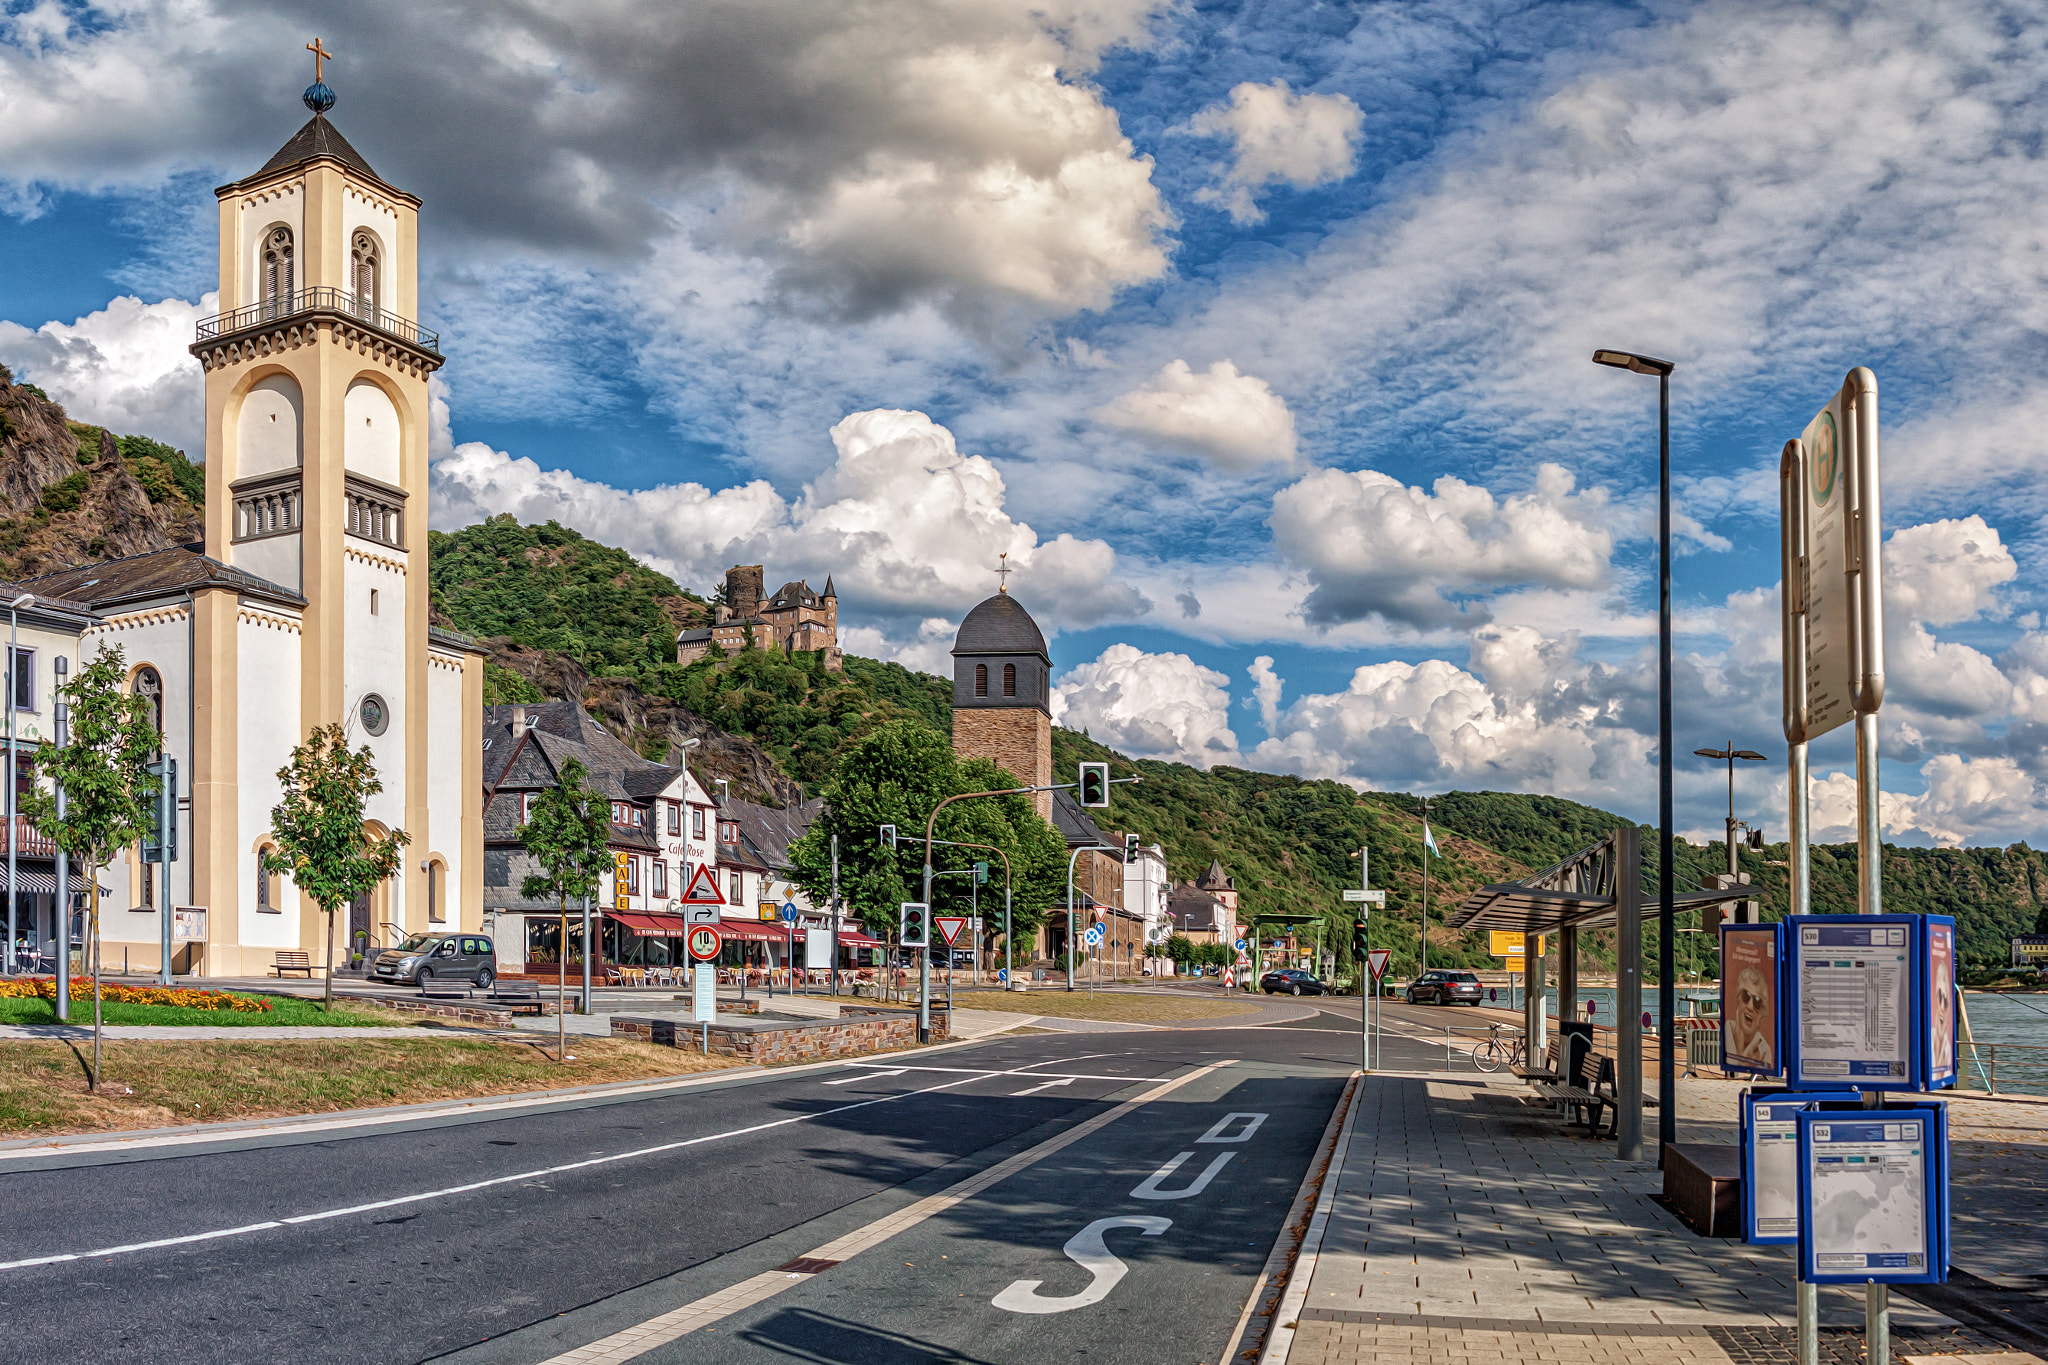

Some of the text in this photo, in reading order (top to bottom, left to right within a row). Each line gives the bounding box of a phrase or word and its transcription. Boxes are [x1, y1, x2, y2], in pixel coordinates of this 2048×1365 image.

[1817, 427, 1830, 487] H
[687, 844, 704, 857] Rose
[698, 932, 710, 945] 10
[1815, 1129, 1829, 1137] 532
